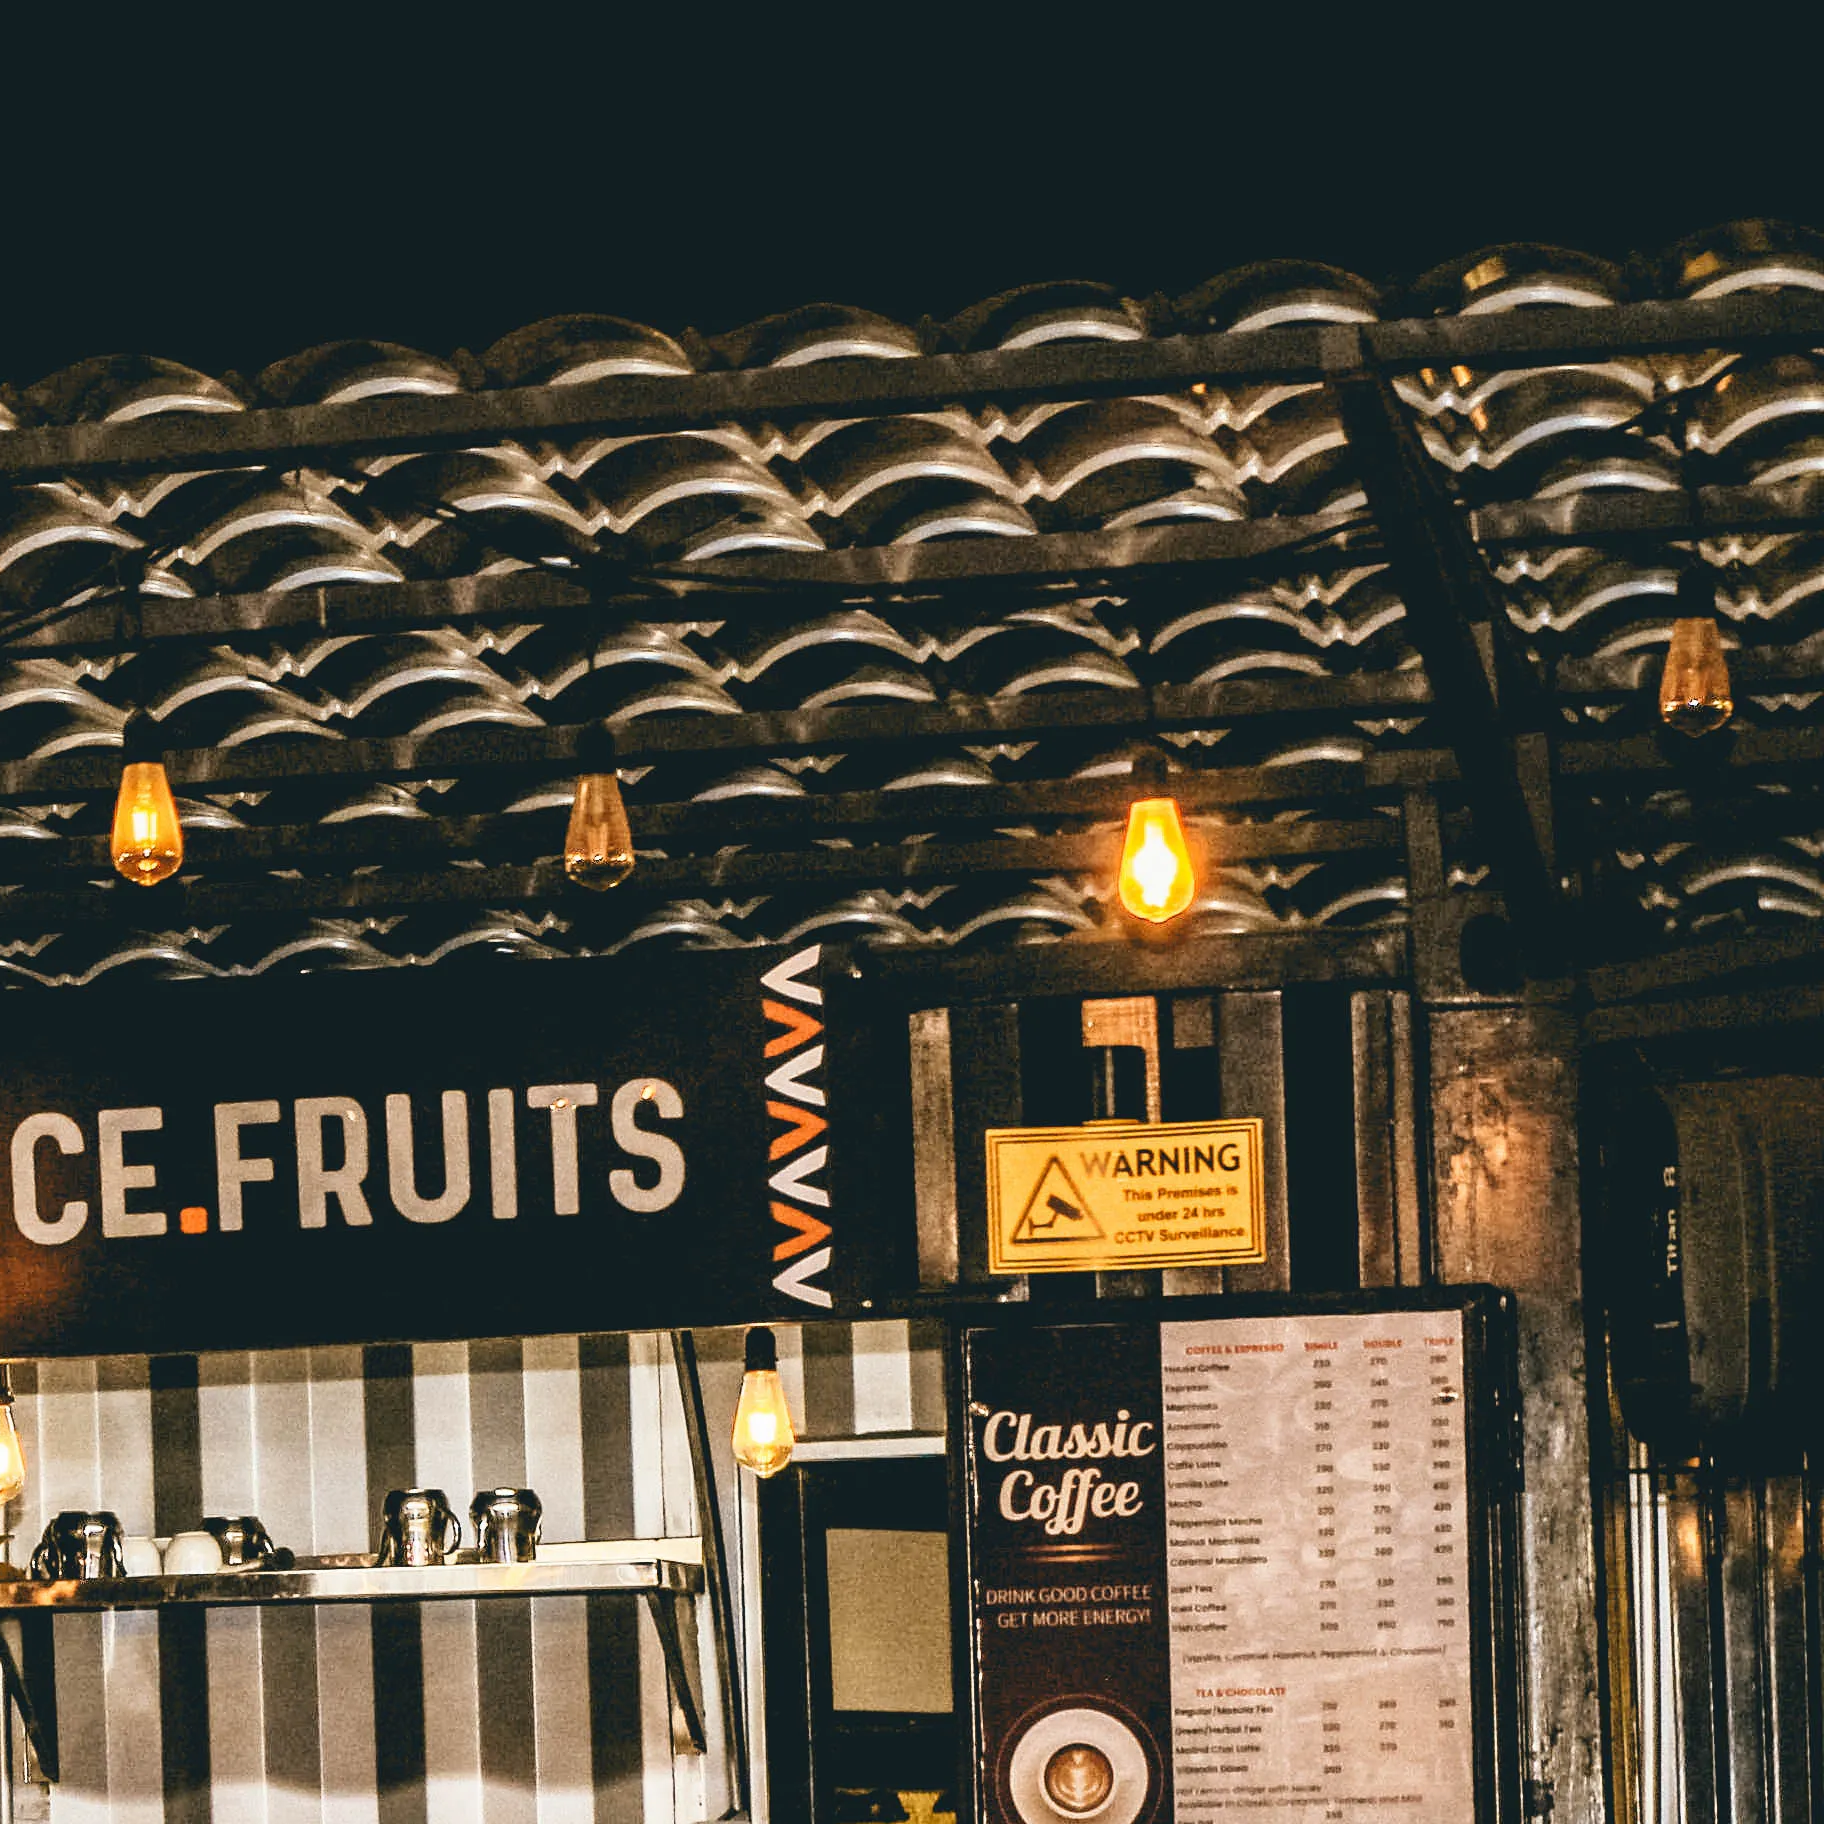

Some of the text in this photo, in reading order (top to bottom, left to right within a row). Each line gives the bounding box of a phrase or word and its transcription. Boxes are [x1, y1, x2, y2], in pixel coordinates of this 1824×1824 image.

[1079, 1143, 1241, 1178] WARNING
[1123, 1185, 1239, 1202] This Premises is
[1137, 1206, 1226, 1222] under 24 hrs
[1113, 1226, 1245, 1245] CCTV Surveillance
[983, 1409, 1158, 1462] Classic
[999, 1468, 1144, 1535] Coffee
[986, 1584, 1153, 1605] DRINK GOOD COFFEE
[997, 1611, 1029, 1629] GET
[1032, 1609, 1080, 1627] MORE
